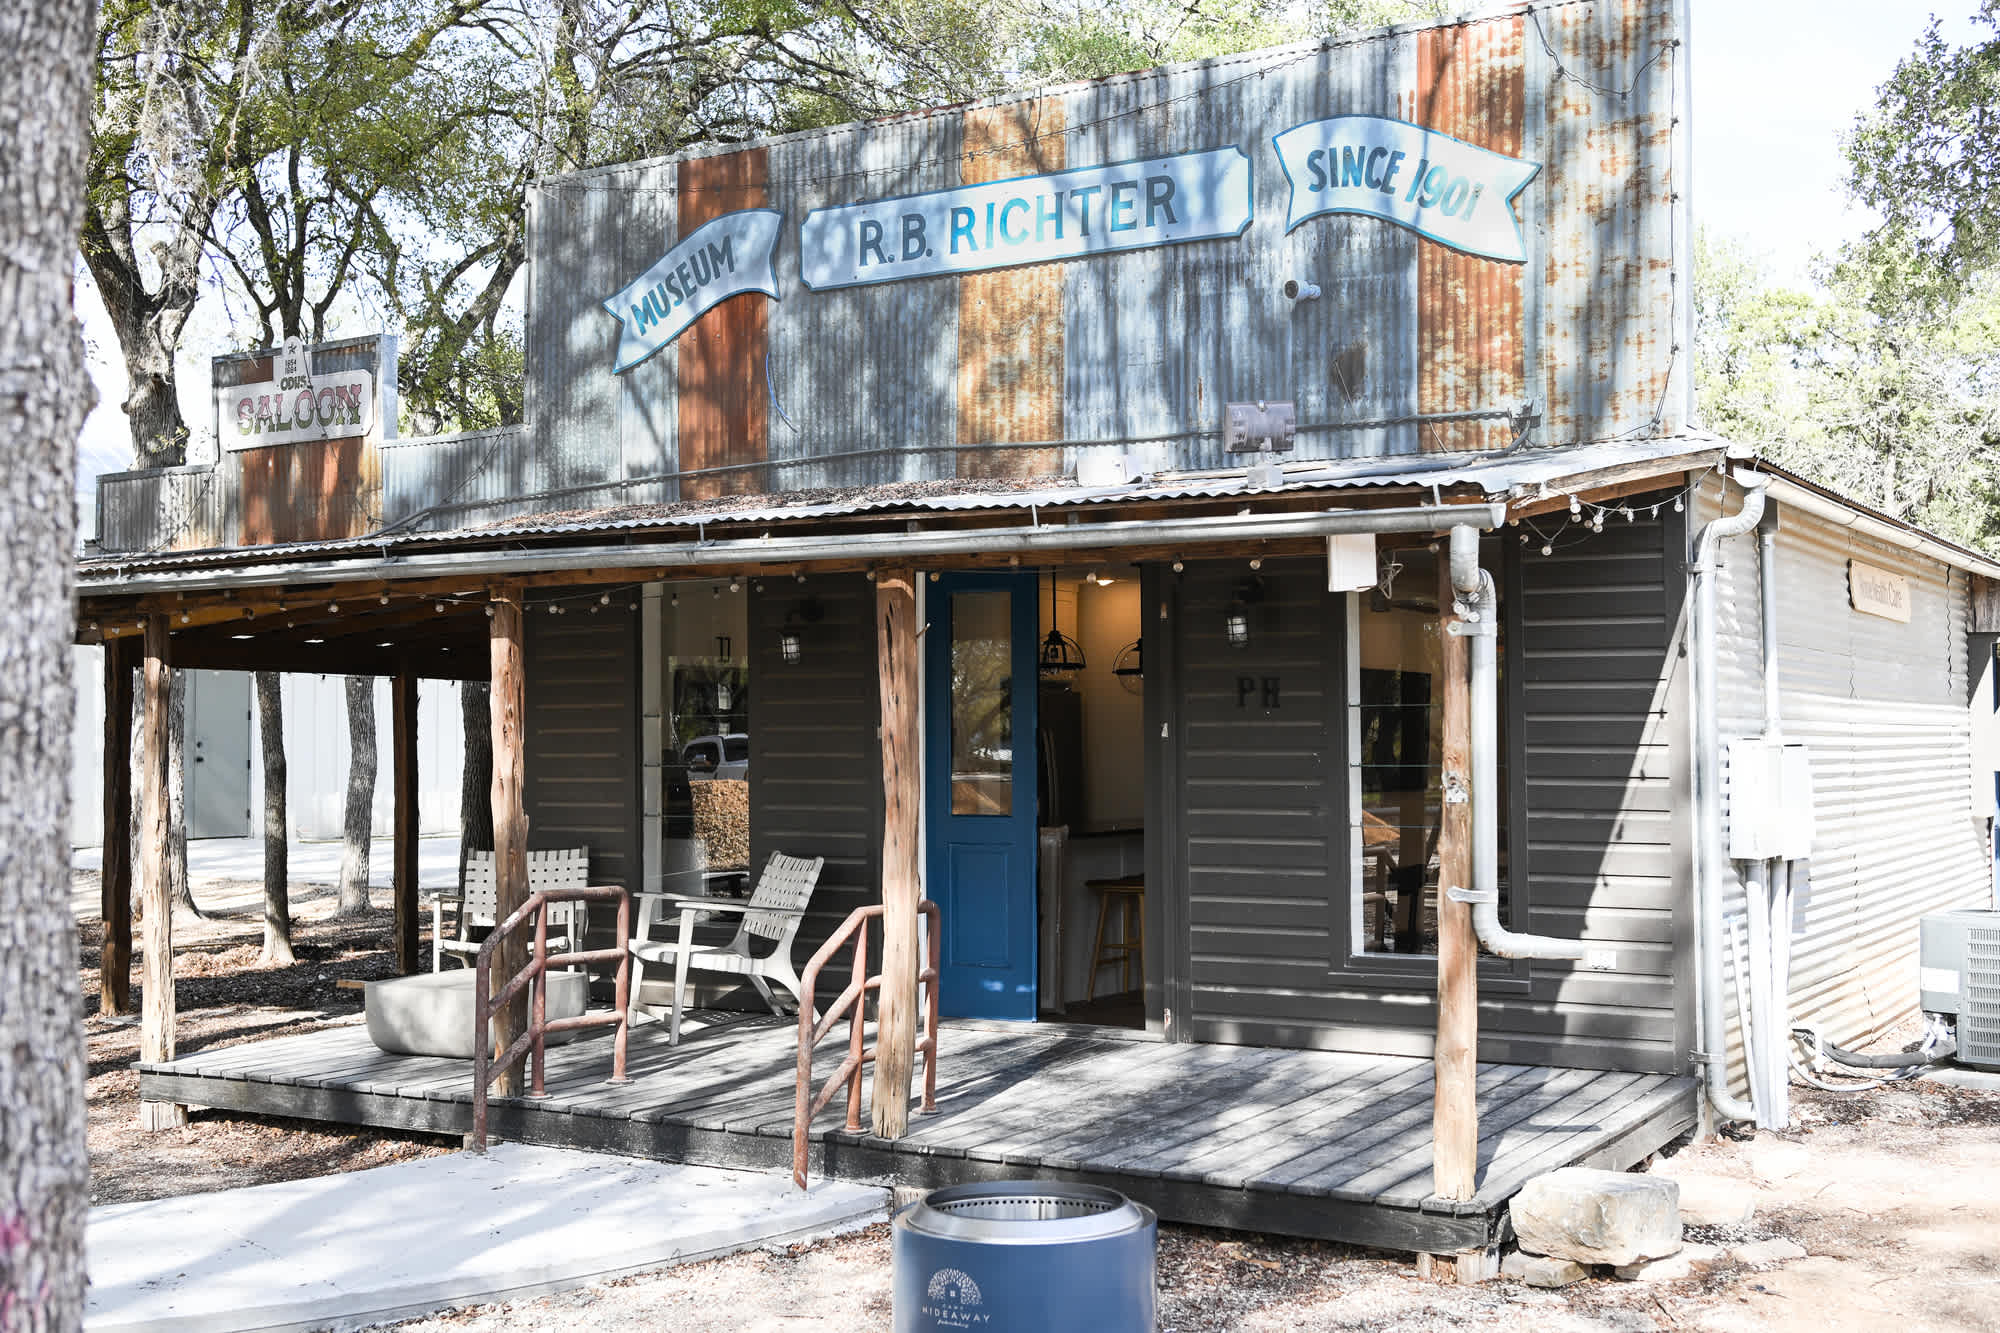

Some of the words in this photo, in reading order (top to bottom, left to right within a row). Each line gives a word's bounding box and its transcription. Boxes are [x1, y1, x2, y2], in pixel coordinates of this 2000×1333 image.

[858, 214, 933, 267] R.B.
[949, 175, 1178, 255] RICHTER
[1307, 146, 1406, 195] SINCE
[1404, 159, 1484, 222] 1901
[630, 234, 735, 336] MUSEUM
[237, 384, 362, 435] SALOON
[922, 1305, 991, 1322] HIDEAWAY
